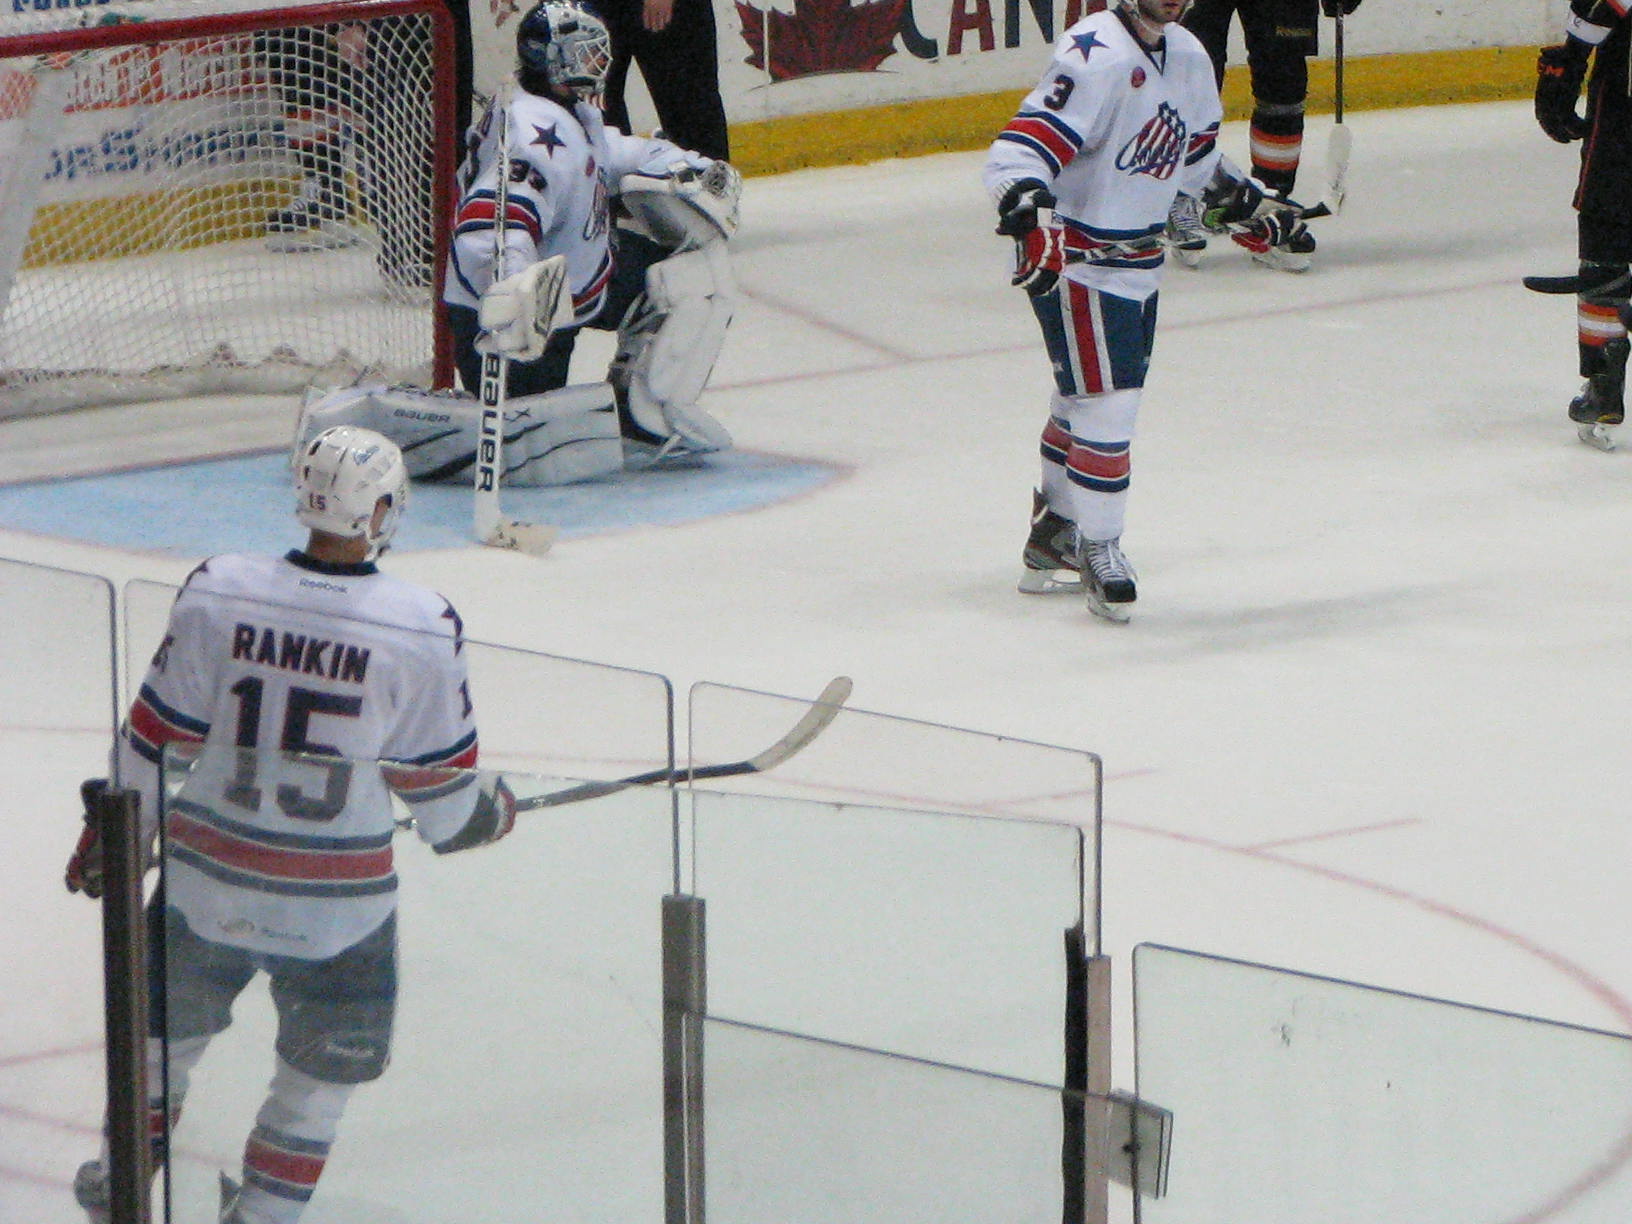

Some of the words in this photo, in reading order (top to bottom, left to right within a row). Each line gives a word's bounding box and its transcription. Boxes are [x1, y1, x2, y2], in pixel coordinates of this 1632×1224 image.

[1044, 73, 1075, 111] 3
[479, 353, 500, 492] BAUER
[310, 492, 326, 511] 15
[232, 622, 371, 684] RANKIN
[223, 676, 363, 824] 15
